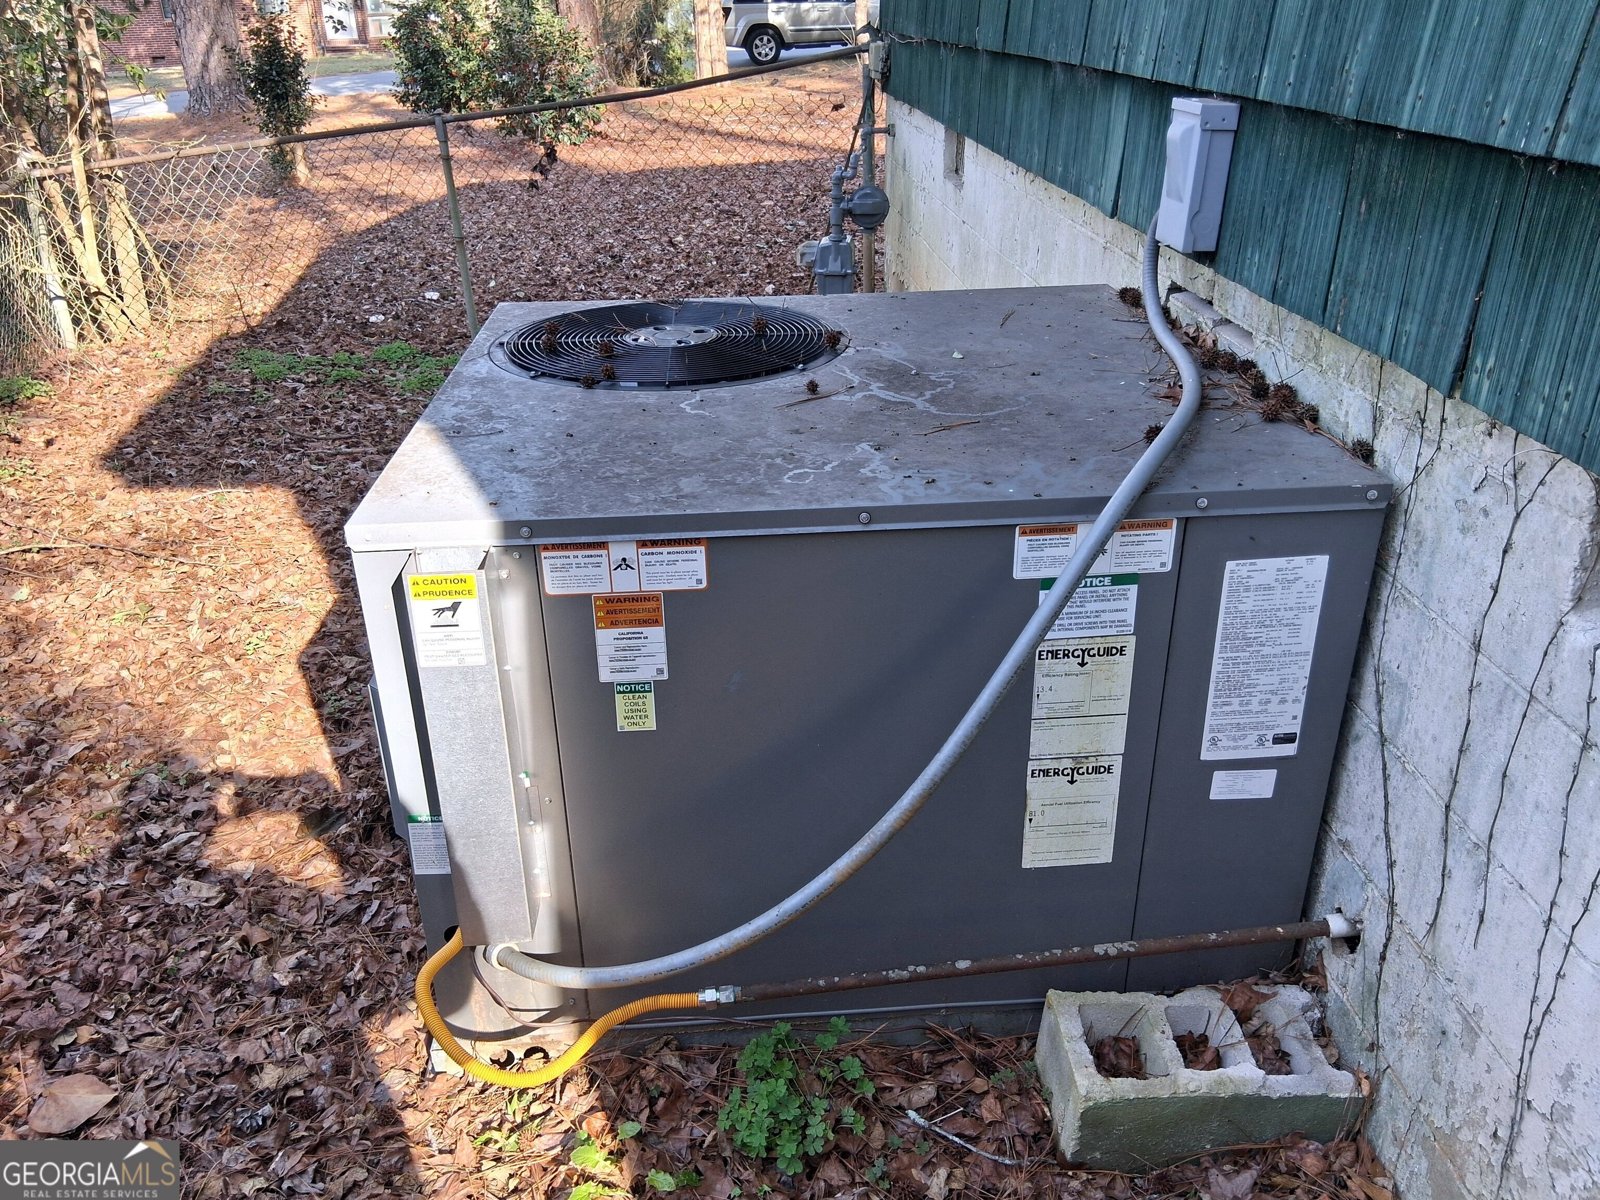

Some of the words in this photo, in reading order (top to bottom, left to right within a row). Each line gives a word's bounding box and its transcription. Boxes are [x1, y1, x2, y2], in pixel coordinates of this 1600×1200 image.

[1127, 521, 1168, 529] WARNING
[1079, 577, 1112, 587] TICE
[604, 596, 660, 604] WARNING
[606, 607, 660, 615] AVERTISSEMENT
[609, 618, 659, 626] ADVERTENCIA
[1038, 646, 1127, 664] ENERGYGUIDE
[1036, 685, 1053, 693] 13.4
[1031, 764, 1114, 782] ENERGYGUIDE
